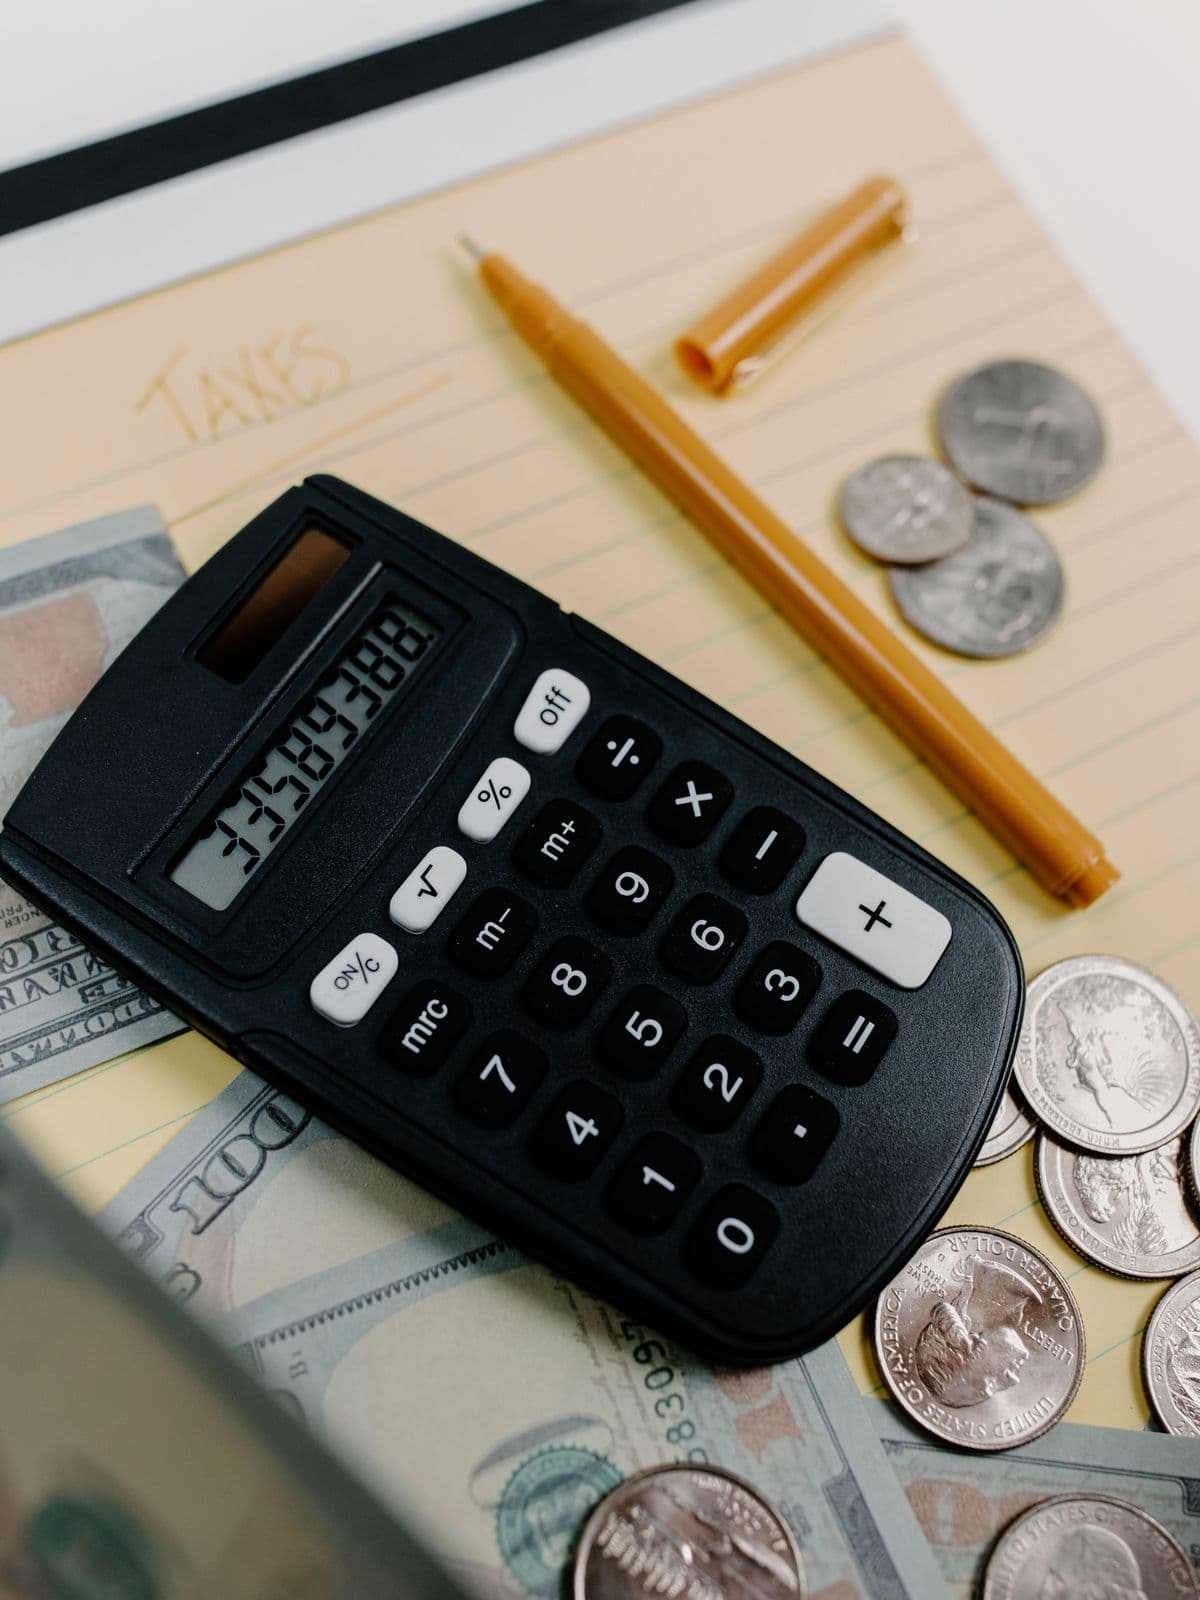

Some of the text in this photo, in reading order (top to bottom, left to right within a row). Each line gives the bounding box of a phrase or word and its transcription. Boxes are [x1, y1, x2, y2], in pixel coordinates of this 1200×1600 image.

[133, 322, 350, 443] TAXES
[539, 685, 572, 726] off
[477, 778, 512, 811] %
[540, 819, 576, 862] m+
[614, 871, 650, 904] 9
[690, 918, 725, 952] 6
[333, 952, 381, 991] ON/C
[550, 962, 588, 997] 8
[764, 968, 800, 1002] 3
[401, 998, 449, 1054] mrc
[624, 1010, 664, 1047] 5
[479, 1054, 517, 1094] 7
[702, 1062, 744, 1103] 2
[564, 1110, 600, 1146] 4
[168, 1085, 312, 1235] 100
[642, 1165, 676, 1193] 1
[716, 1217, 755, 1255] 0
[915, 1261, 948, 1287] TRUST
[946, 1236, 1075, 1333] QUARTER DOLLAR
[879, 1286, 1057, 1439] UNITED STATES OF AMERICA
[1022, 1320, 1076, 1368] LIBERTY
